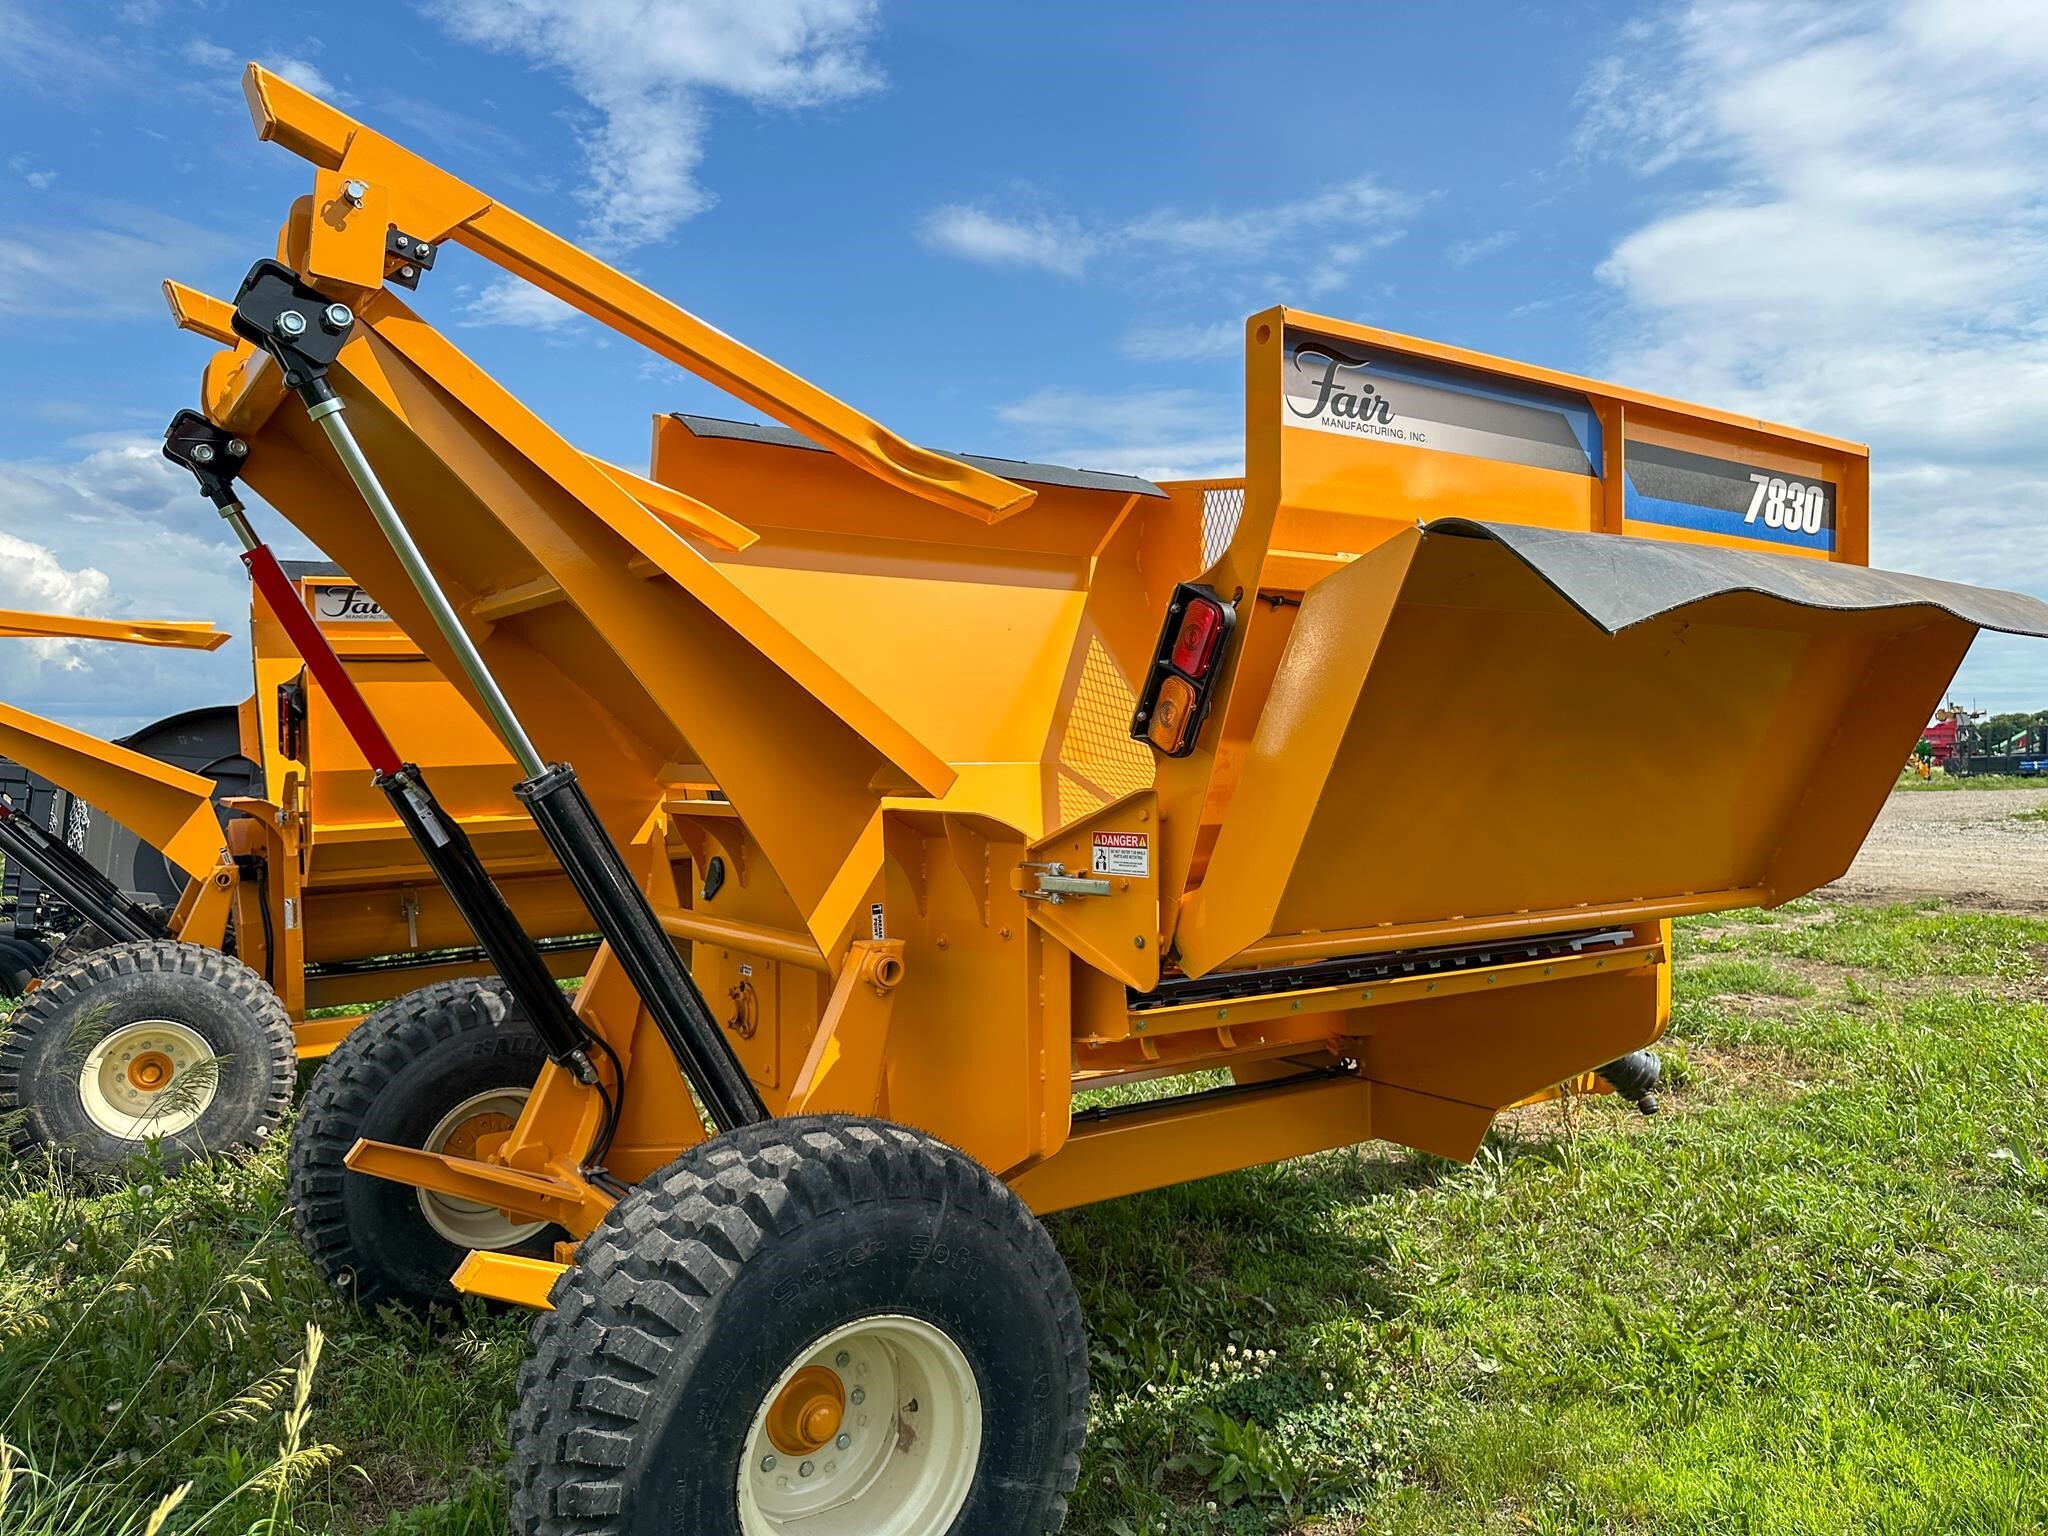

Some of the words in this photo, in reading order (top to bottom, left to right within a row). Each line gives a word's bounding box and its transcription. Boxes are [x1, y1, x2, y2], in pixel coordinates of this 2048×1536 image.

[1286, 342, 1395, 425] Fair
[1321, 417, 1407, 440] MANUFACTURING,
[1409, 431, 1428, 443] INC.
[1744, 473, 1824, 534] 7830
[321, 587, 383, 617] Fai
[1102, 834, 1138, 846] DANGER
